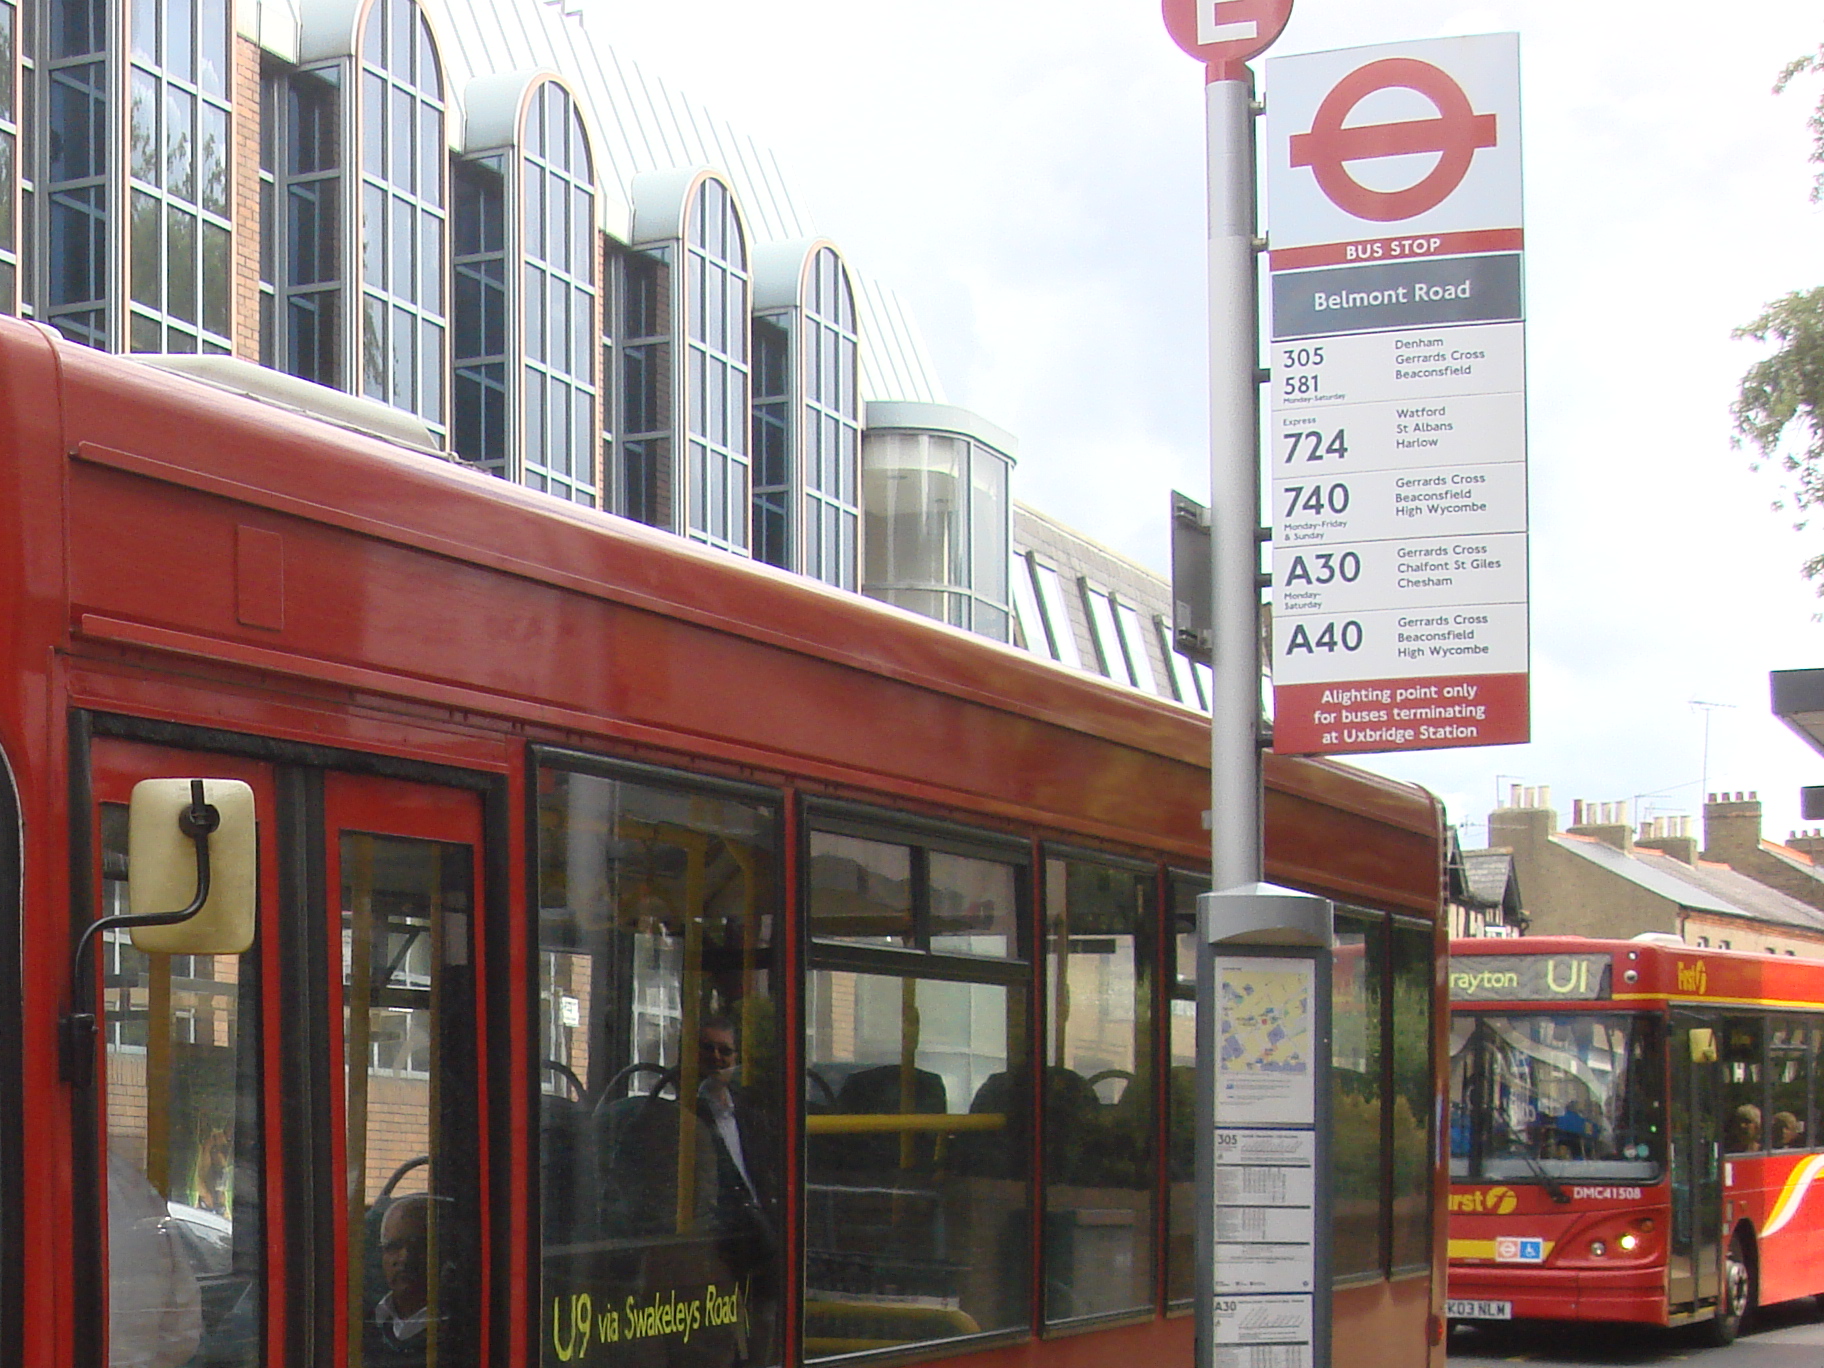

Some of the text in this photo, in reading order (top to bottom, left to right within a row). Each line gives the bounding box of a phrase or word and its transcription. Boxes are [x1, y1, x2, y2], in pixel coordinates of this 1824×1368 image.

[1346, 239, 1441, 259] BUS STOP
[1315, 281, 1470, 310] Belmont Road
[1395, 338, 1443, 349] Denham
[1283, 347, 1324, 368] 305
[1396, 350, 1485, 364] Gerrards Cross
[1396, 366, 1471, 379] Beaconsfield
[1283, 374, 1319, 395] 581
[1396, 407, 1445, 418] Watford
[1283, 417, 1316, 427] Express
[1396, 422, 1453, 433] St Albans
[1283, 428, 1348, 463] 724
[1396, 439, 1438, 448] Harlow
[1396, 474, 1485, 488] Gerrards Cross
[1284, 483, 1349, 517] 740
[1396, 490, 1472, 502] Beaconsfield
[1396, 502, 1486, 517] High Wycombe
[1284, 520, 1347, 531] Monday-Friday
[1294, 532, 1324, 541] Sunday
[1398, 545, 1487, 558] Gerrards Cross
[1285, 551, 1361, 587] A30
[1398, 559, 1501, 573] Chalfont St Giles
[1398, 577, 1452, 588] Chesham
[1398, 615, 1488, 627] Gerrards Cross
[1286, 620, 1363, 655] A40
[1398, 630, 1474, 642] Beaconsfield
[1398, 644, 1489, 659] High Wycombe
[1322, 684, 1477, 705] Alighting point only
[1314, 704, 1485, 724] for buses terminating
[1322, 725, 1477, 744] at Uxbridge Station
[1217, 1134, 1238, 1146] 305
[1574, 1187, 1641, 1200] DMC41508
[1214, 1301, 1237, 1312] A30
[554, 1281, 739, 1362] U9 via Swakeleys Road
